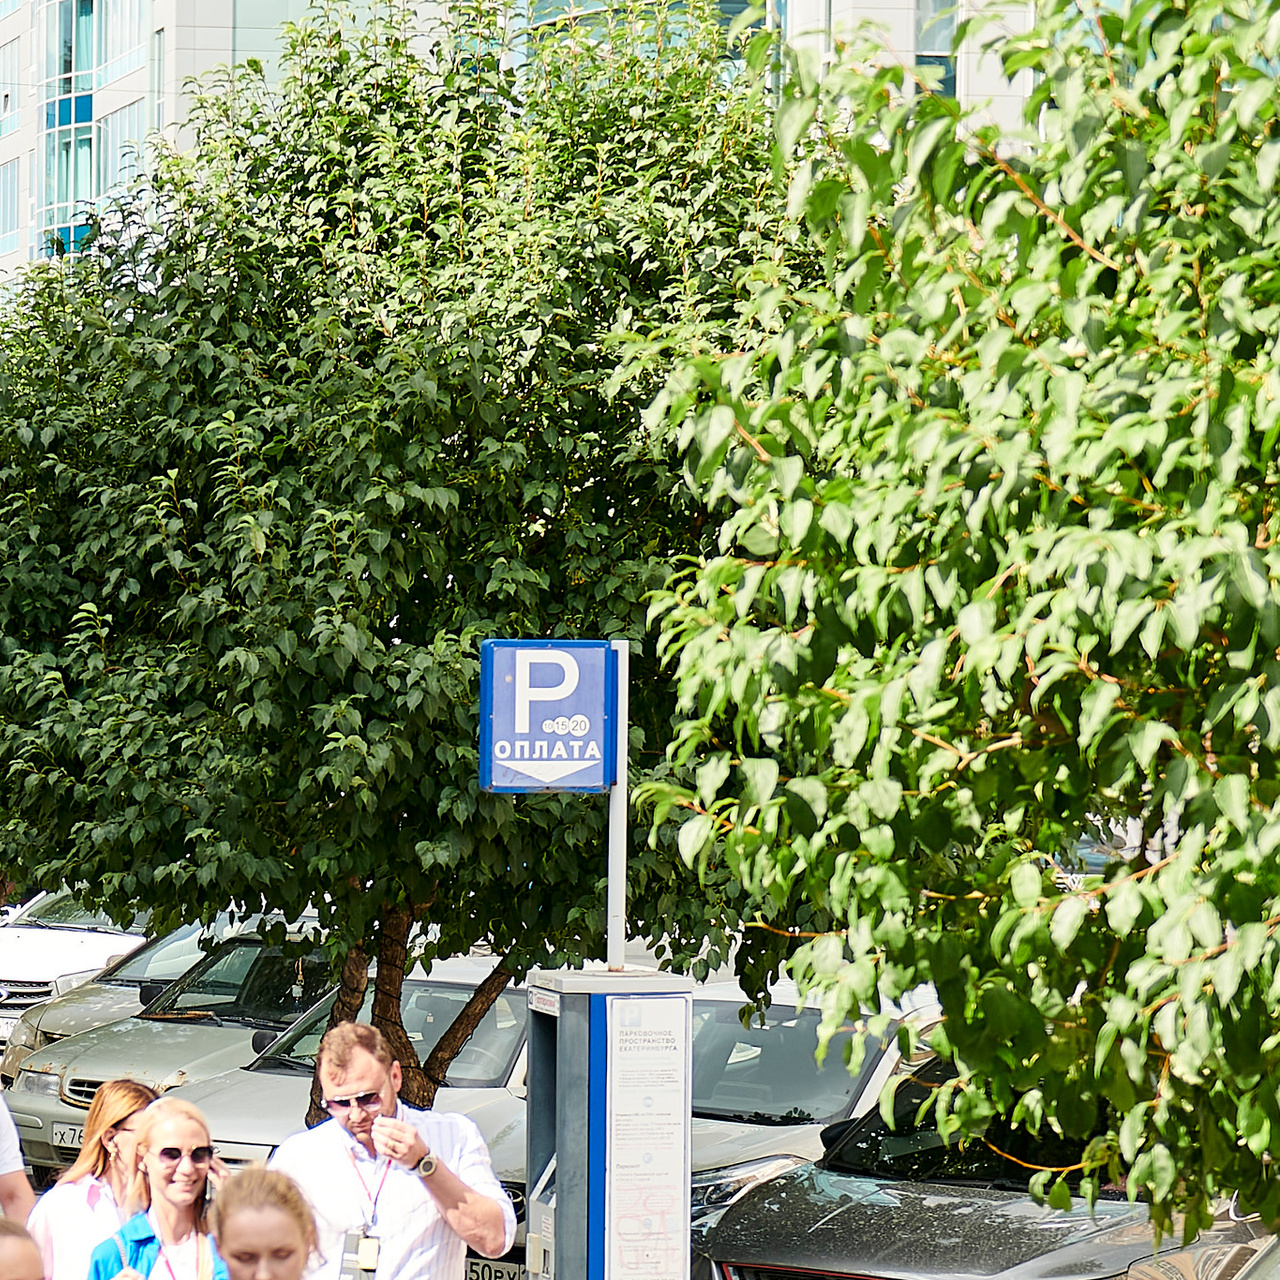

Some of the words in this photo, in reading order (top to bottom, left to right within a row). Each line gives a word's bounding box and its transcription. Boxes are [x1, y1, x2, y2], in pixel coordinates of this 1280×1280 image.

[515, 649, 580, 734] P
[556, 721, 568, 731] 15
[571, 720, 587, 732] 20
[494, 740, 602, 759] ОПЛАТА
[619, 1030, 673, 1038] ПАРКОВОЧНОЕ
[619, 1037, 677, 1045] ПРОСТРАНСТВО
[619, 1045, 678, 1053] ЕКАТЕРИНБУРГА
